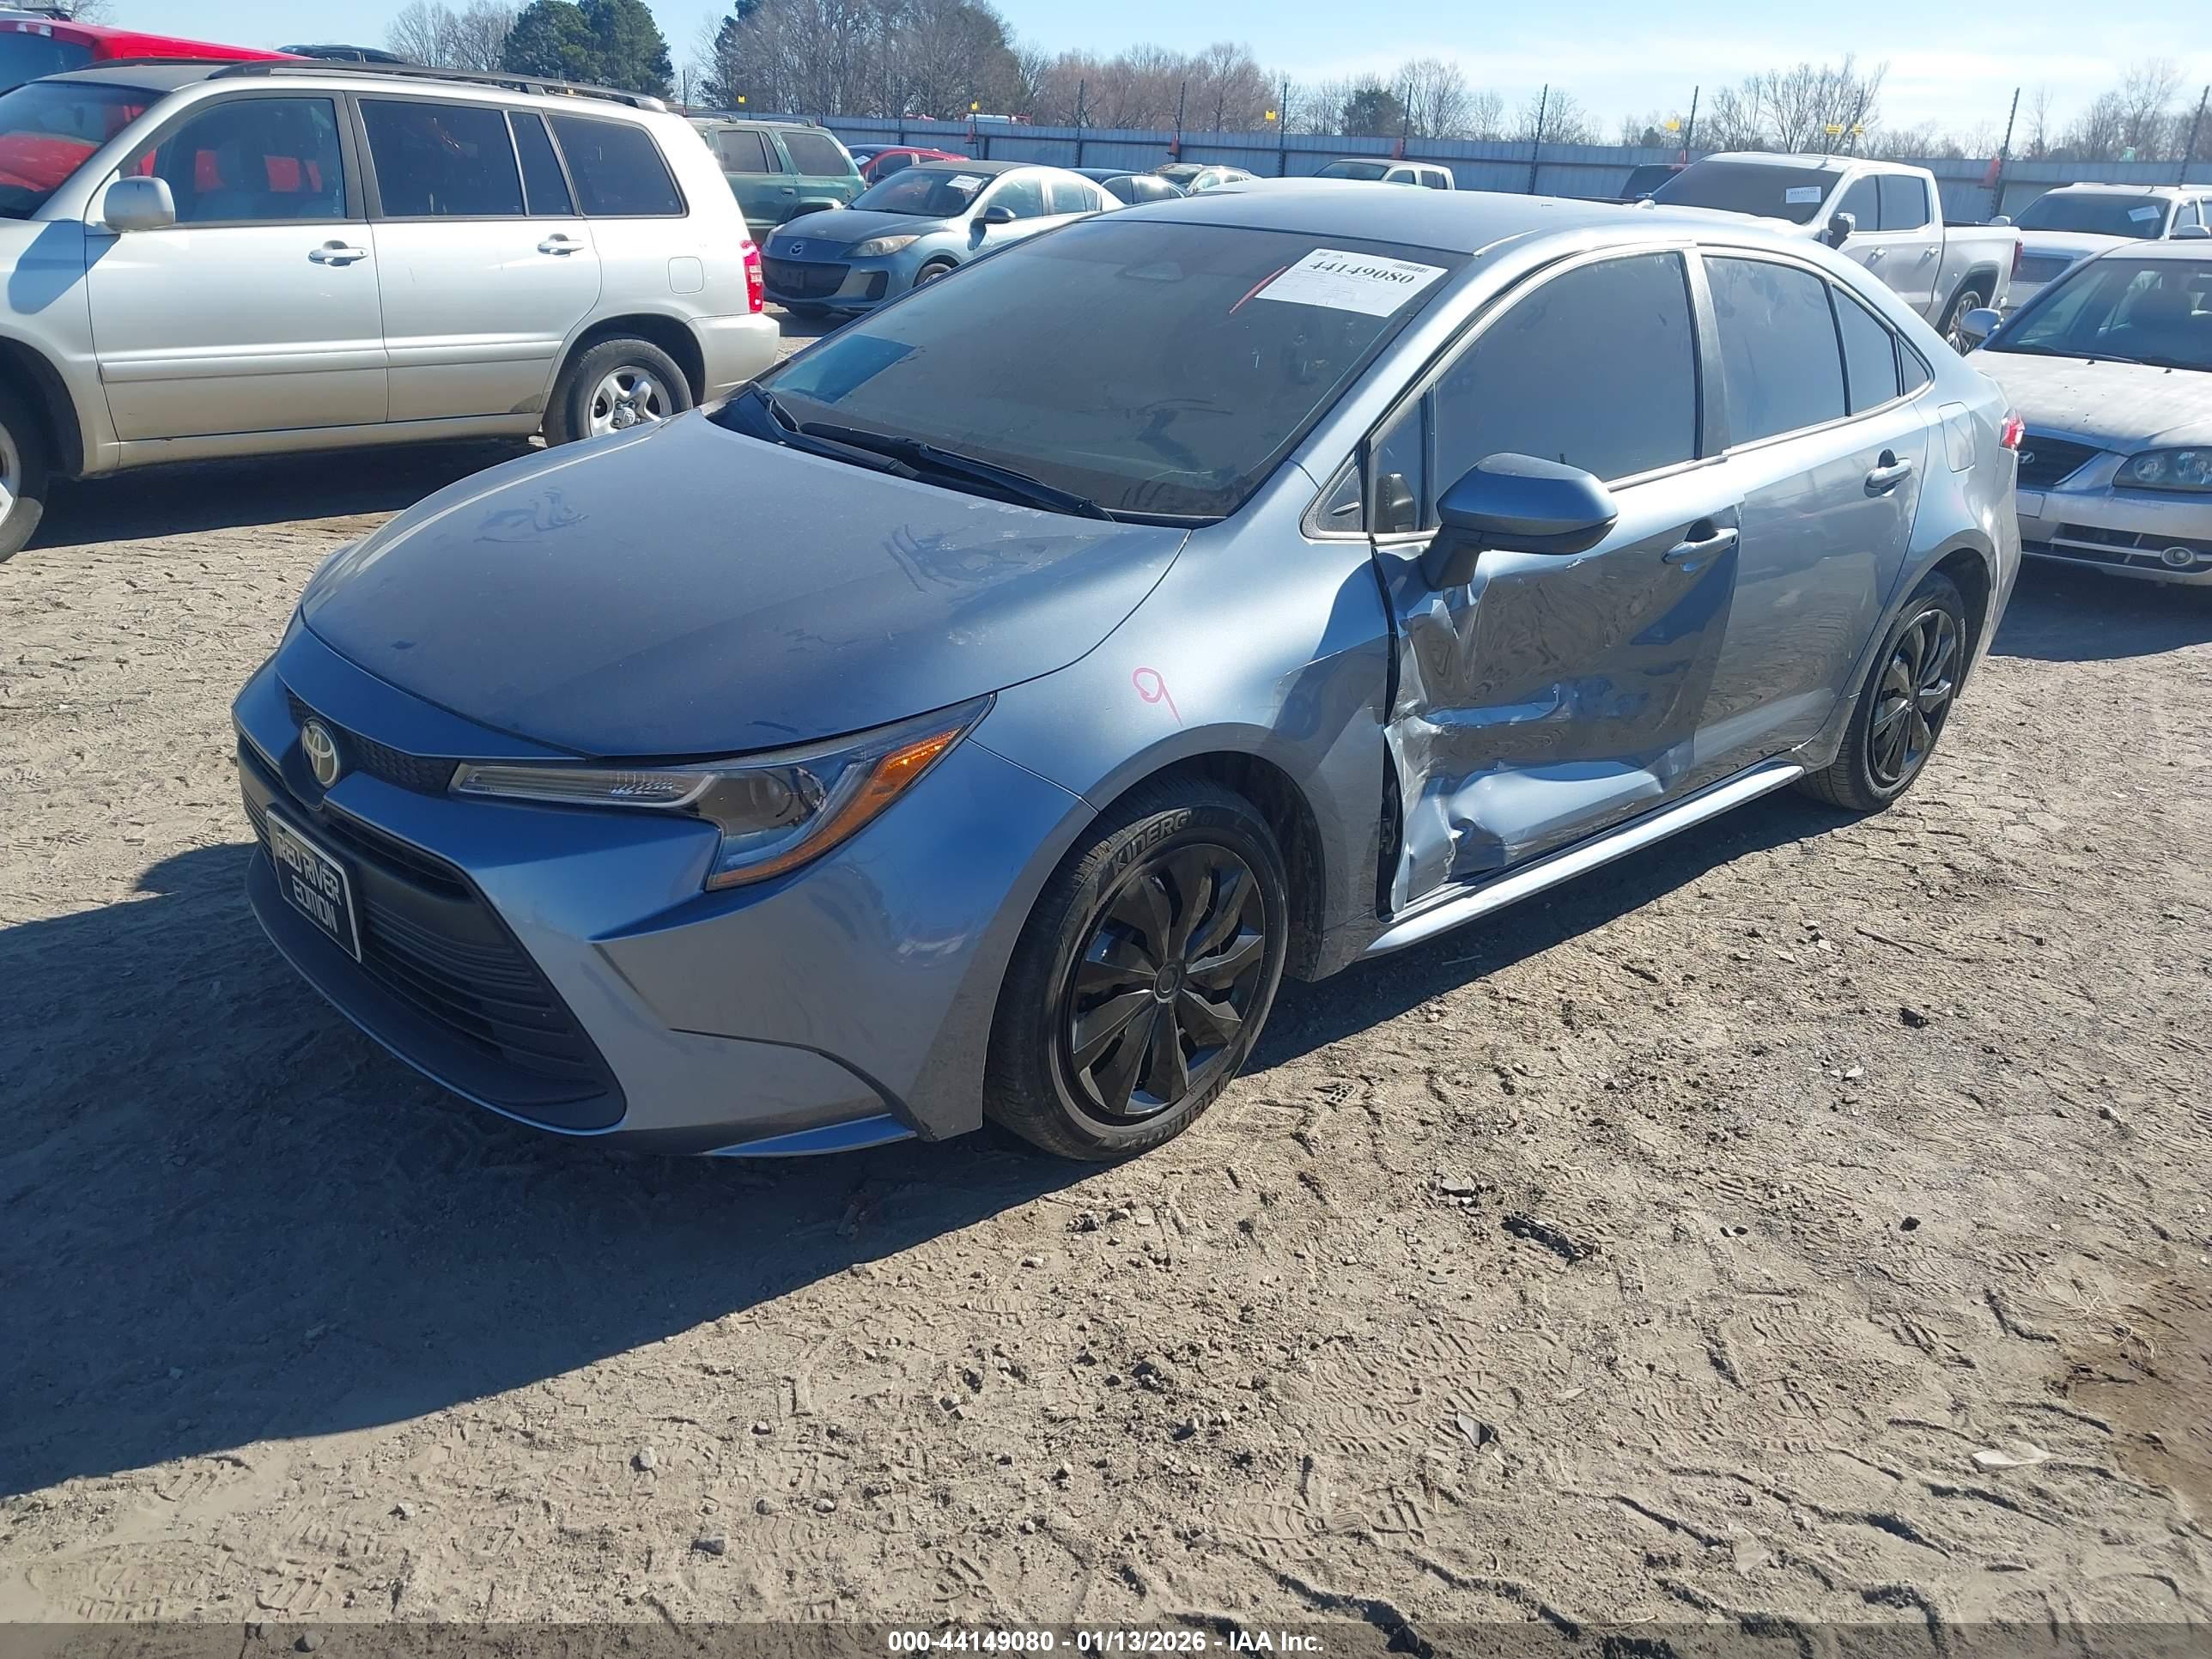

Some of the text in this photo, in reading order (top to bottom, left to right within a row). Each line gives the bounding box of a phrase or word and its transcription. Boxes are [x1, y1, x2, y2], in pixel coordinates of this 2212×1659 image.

[1309, 260, 1416, 285] 44149080
[1132, 666, 1183, 727] 9
[275, 832, 343, 907] RED RIVER
[291, 874, 339, 934] EDITION
